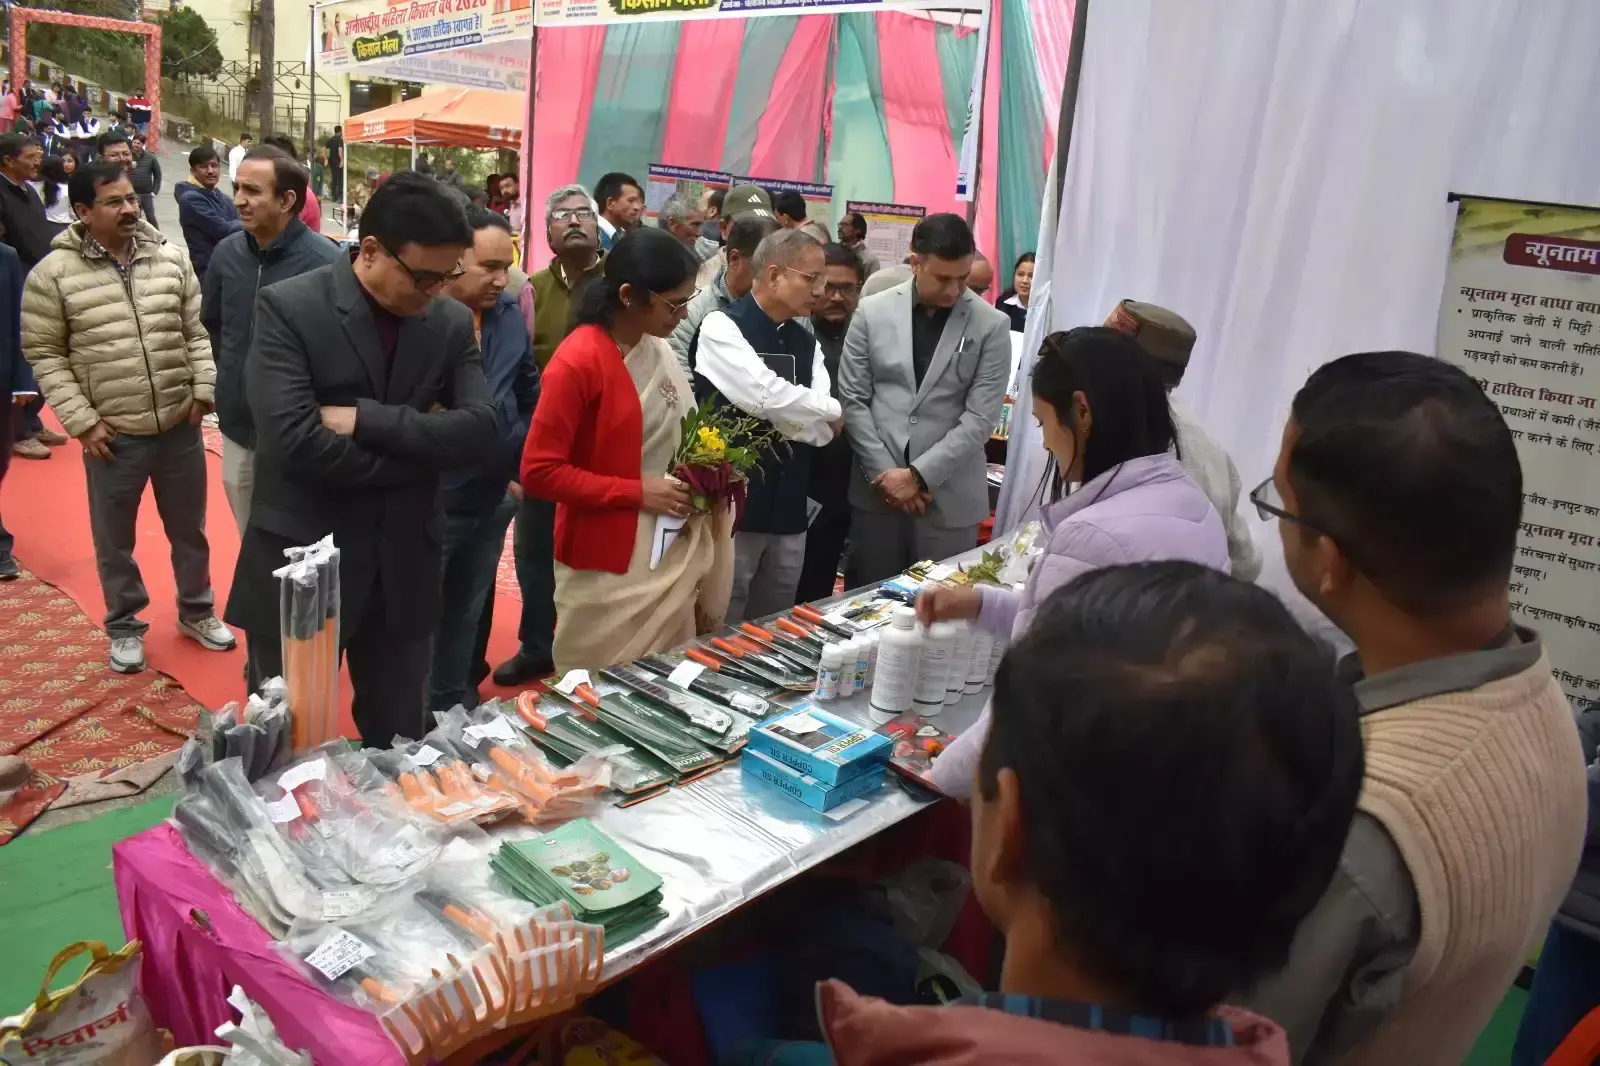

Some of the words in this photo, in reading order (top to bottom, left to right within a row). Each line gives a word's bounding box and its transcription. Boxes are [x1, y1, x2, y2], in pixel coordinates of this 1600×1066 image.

[382, 7, 408, 27] महिला
[409, 1, 438, 21] किसान
[356, 40, 381, 58] किसान
[382, 36, 399, 53] मेला
[1525, 241, 1597, 266] न्यूनतम
[1460, 286, 1507, 303] न्यूनतम
[1510, 292, 1537, 307] मृदा
[1540, 296, 1573, 311] बाधा
[1472, 308, 1516, 323] प्राकृतिक
[1523, 313, 1546, 328] खेती
[1552, 316, 1562, 329] में
[1568, 319, 1592, 336] मिट्टी
[1468, 328, 1503, 343] अपनाई
[1510, 333, 1531, 347] जाने
[1539, 339, 1567, 352] वाली
[1463, 349, 1500, 366] गड़बड़ी
[1502, 352, 1517, 365] को
[1519, 357, 1538, 369] कम
[1540, 361, 1569, 374] करती
[1492, 382, 1536, 399] हासिल
[1539, 388, 1574, 406] किया
[1577, 396, 1597, 409] जा
[1501, 406, 1537, 420] प्रथाओं
[1540, 411, 1550, 422] में
[1551, 414, 1576, 426] कमी
[1527, 432, 1552, 446] करने
[1555, 435, 1568, 448] के
[1571, 437, 1595, 455] लिए
[1568, 531, 1595, 546] मृदा
[1520, 546, 1556, 562] संरचना
[1557, 552, 1568, 564] में
[1568, 557, 1597, 570] सुधार
[1563, 615, 1587, 629] कृषि
[770, 747, 782, 757] SIL
[761, 769, 773, 782] SIL
[783, 754, 813, 774] COPPER
[774, 775, 802, 798] COPPER
